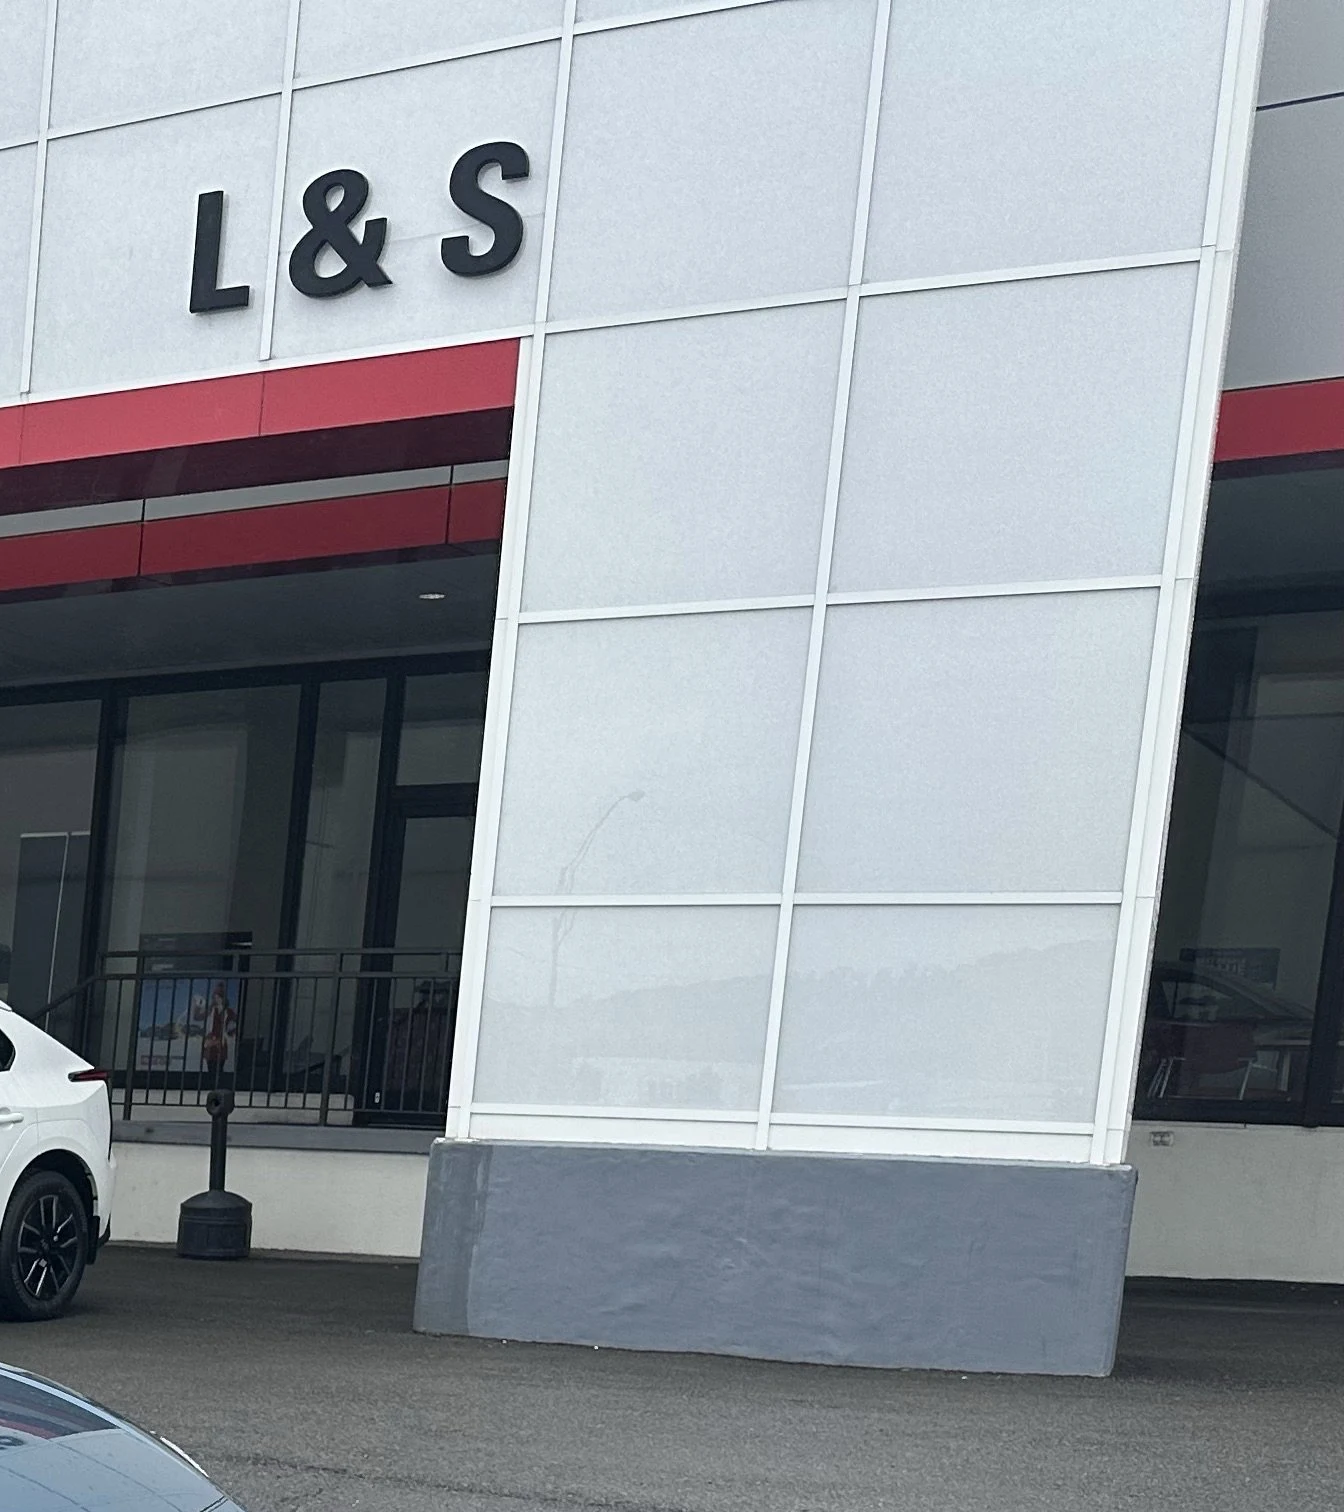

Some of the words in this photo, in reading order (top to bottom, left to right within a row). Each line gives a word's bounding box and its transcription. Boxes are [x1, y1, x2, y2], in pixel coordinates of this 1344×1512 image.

[189, 190, 250, 313] L
[289, 169, 393, 298] &
[441, 141, 530, 277] S
